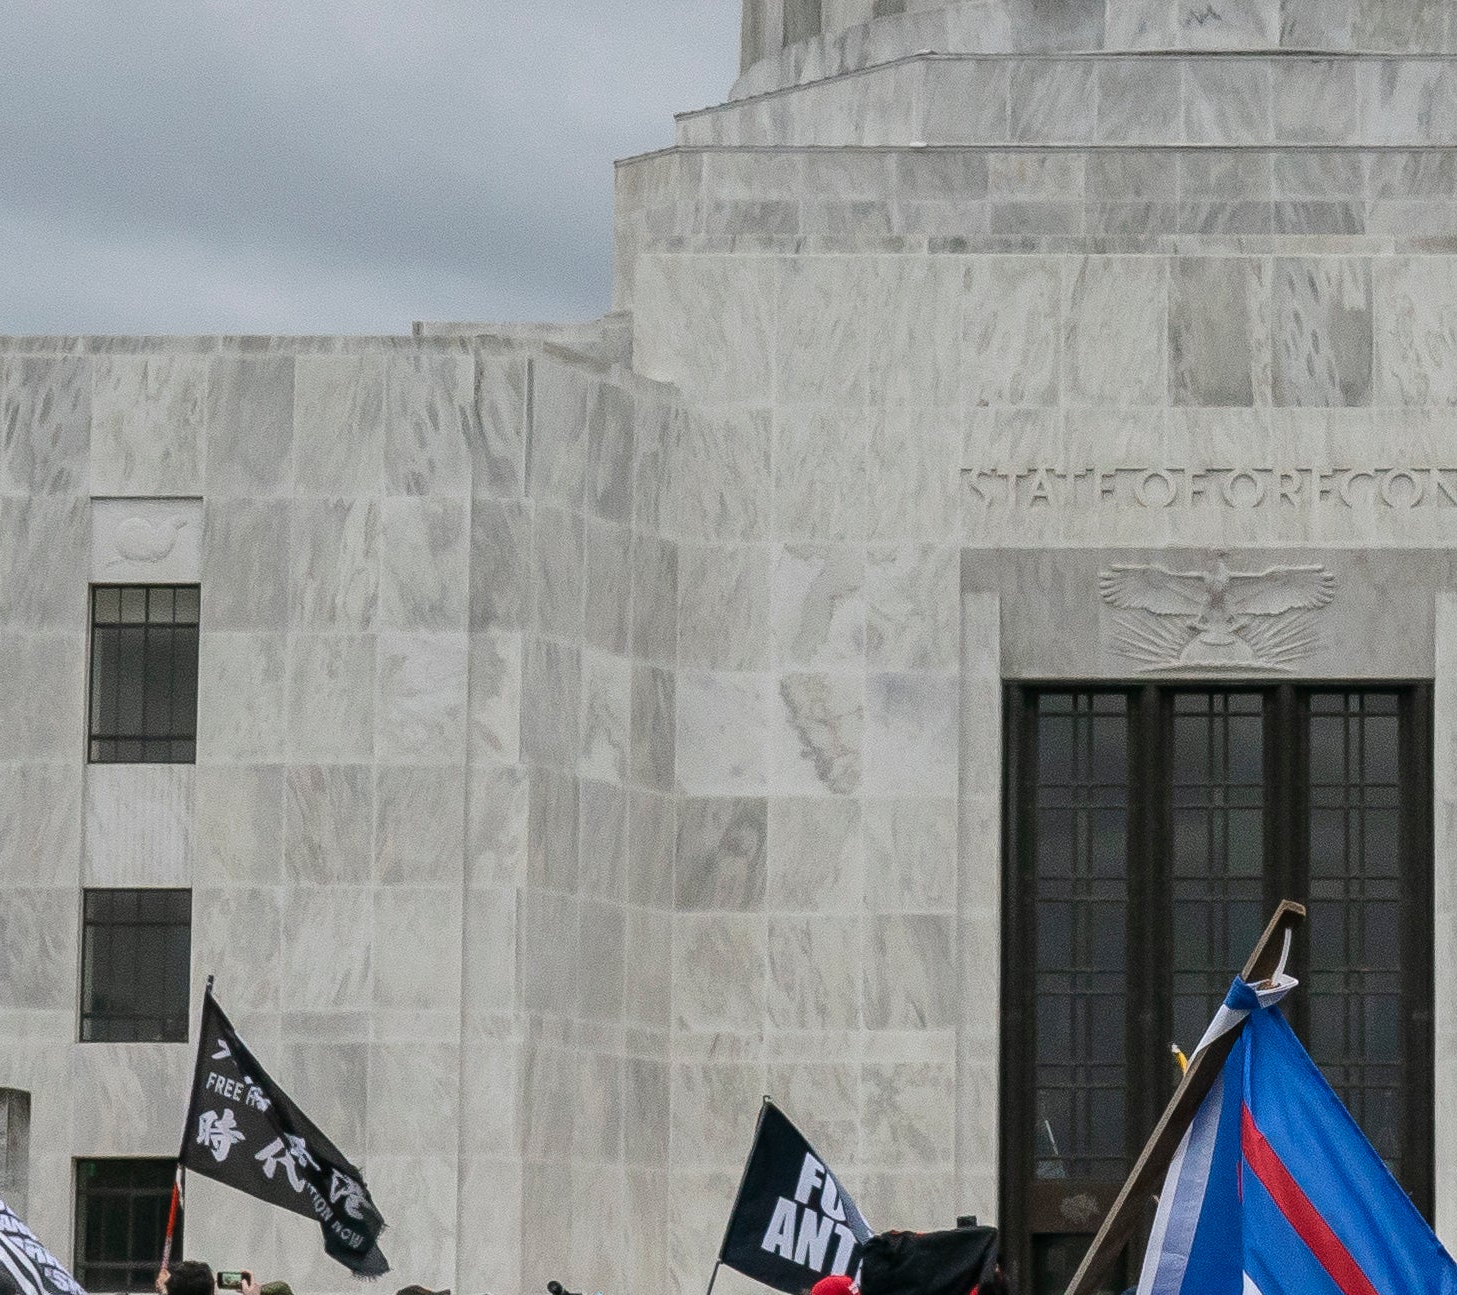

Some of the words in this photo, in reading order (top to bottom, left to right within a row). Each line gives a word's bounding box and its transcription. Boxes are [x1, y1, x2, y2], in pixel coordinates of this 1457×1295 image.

[960, 468, 1120, 507] STATE
[1134, 468, 1210, 507] OF
[206, 1072, 244, 1102] FREE
[794, 1152, 846, 1221] FU
[331, 1220, 365, 1250] NOW
[761, 1196, 862, 1286] ANT
